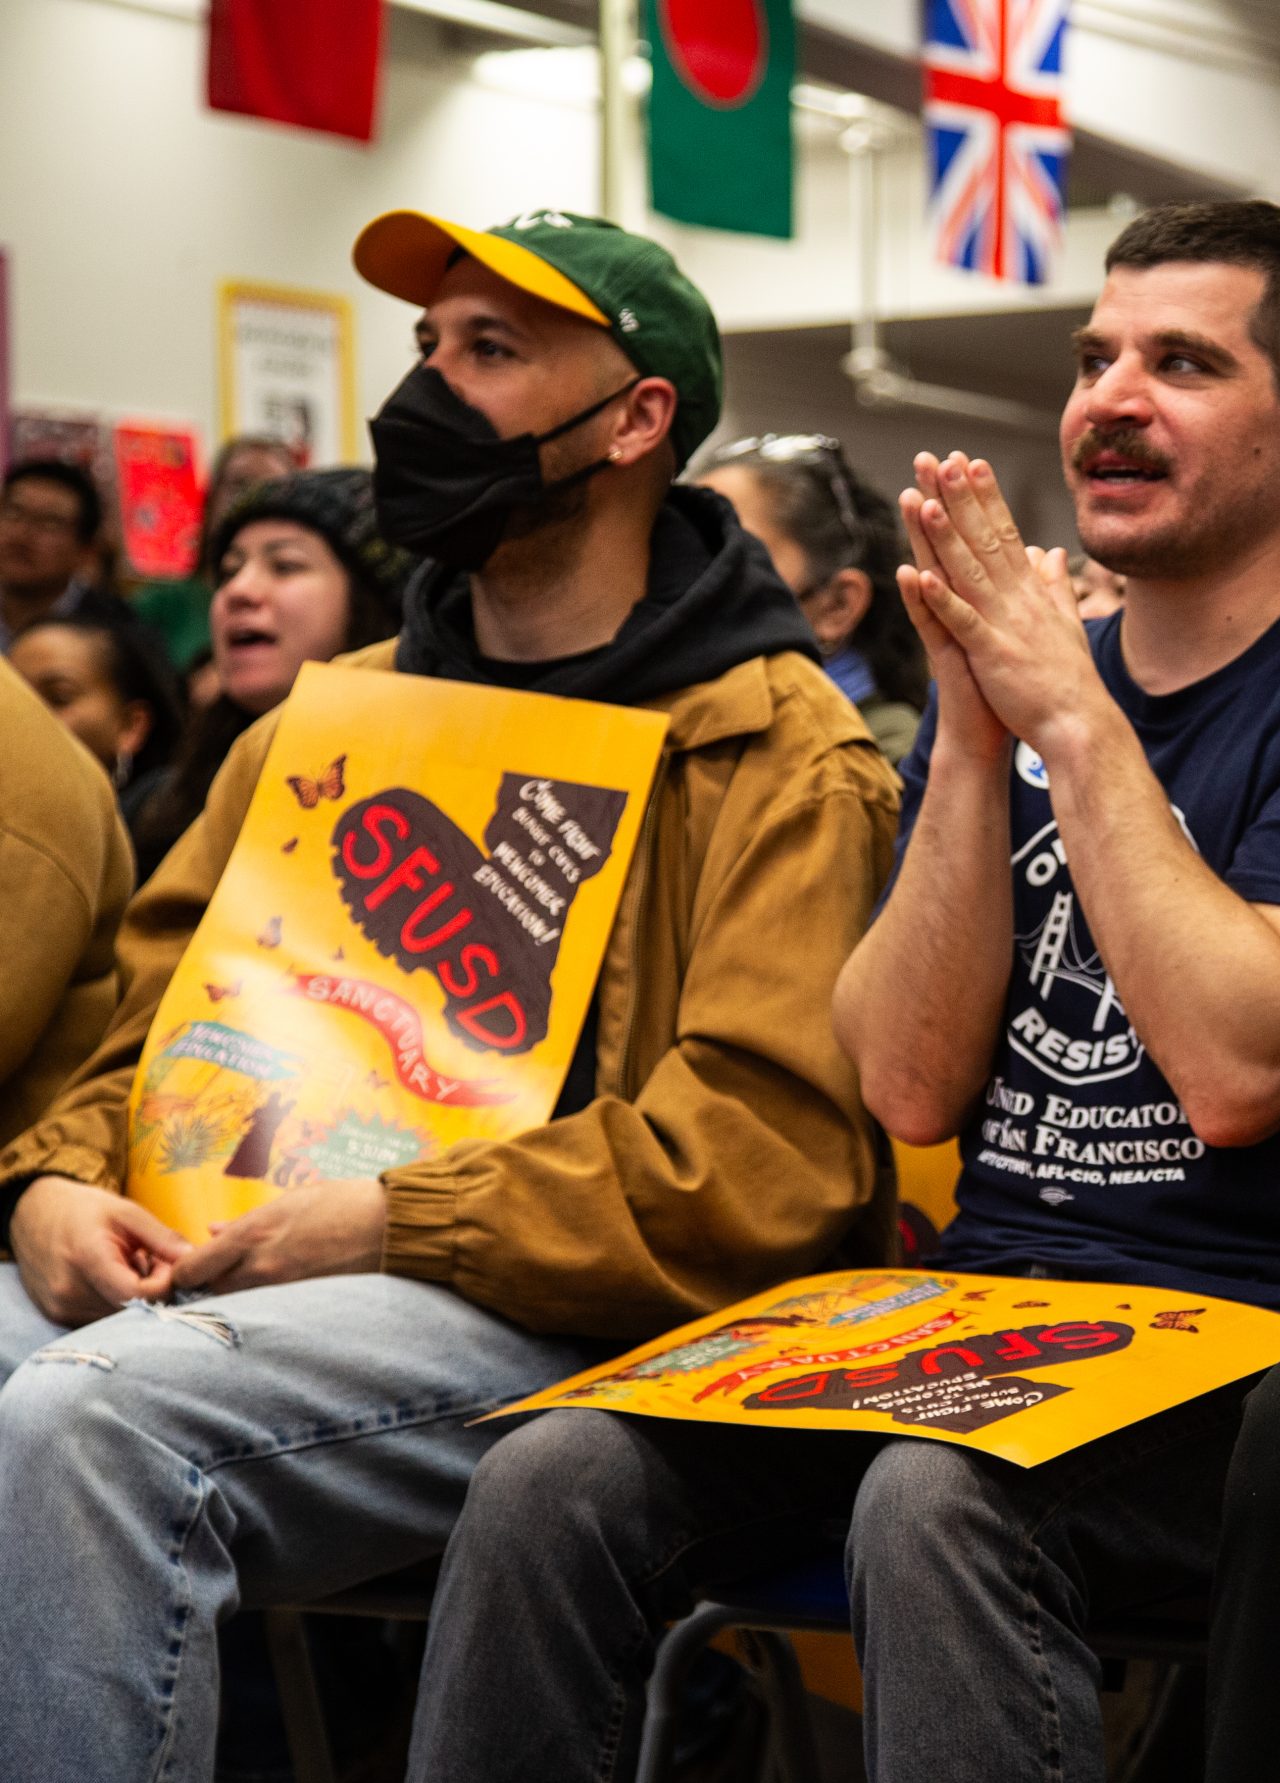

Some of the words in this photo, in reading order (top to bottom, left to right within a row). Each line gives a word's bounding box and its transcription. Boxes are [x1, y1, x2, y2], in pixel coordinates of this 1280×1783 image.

[342, 804, 527, 1048] SFUSD
[306, 975, 461, 1101] SANCTUARY
[1032, 1124, 1205, 1165] FRANCISCO
[1109, 1167, 1186, 1185] NEA/CTA
[738, 1318, 953, 1381] SANCTUARY
[758, 1323, 1119, 1402] SFUSD
[980, 1391, 1044, 1409] COME
